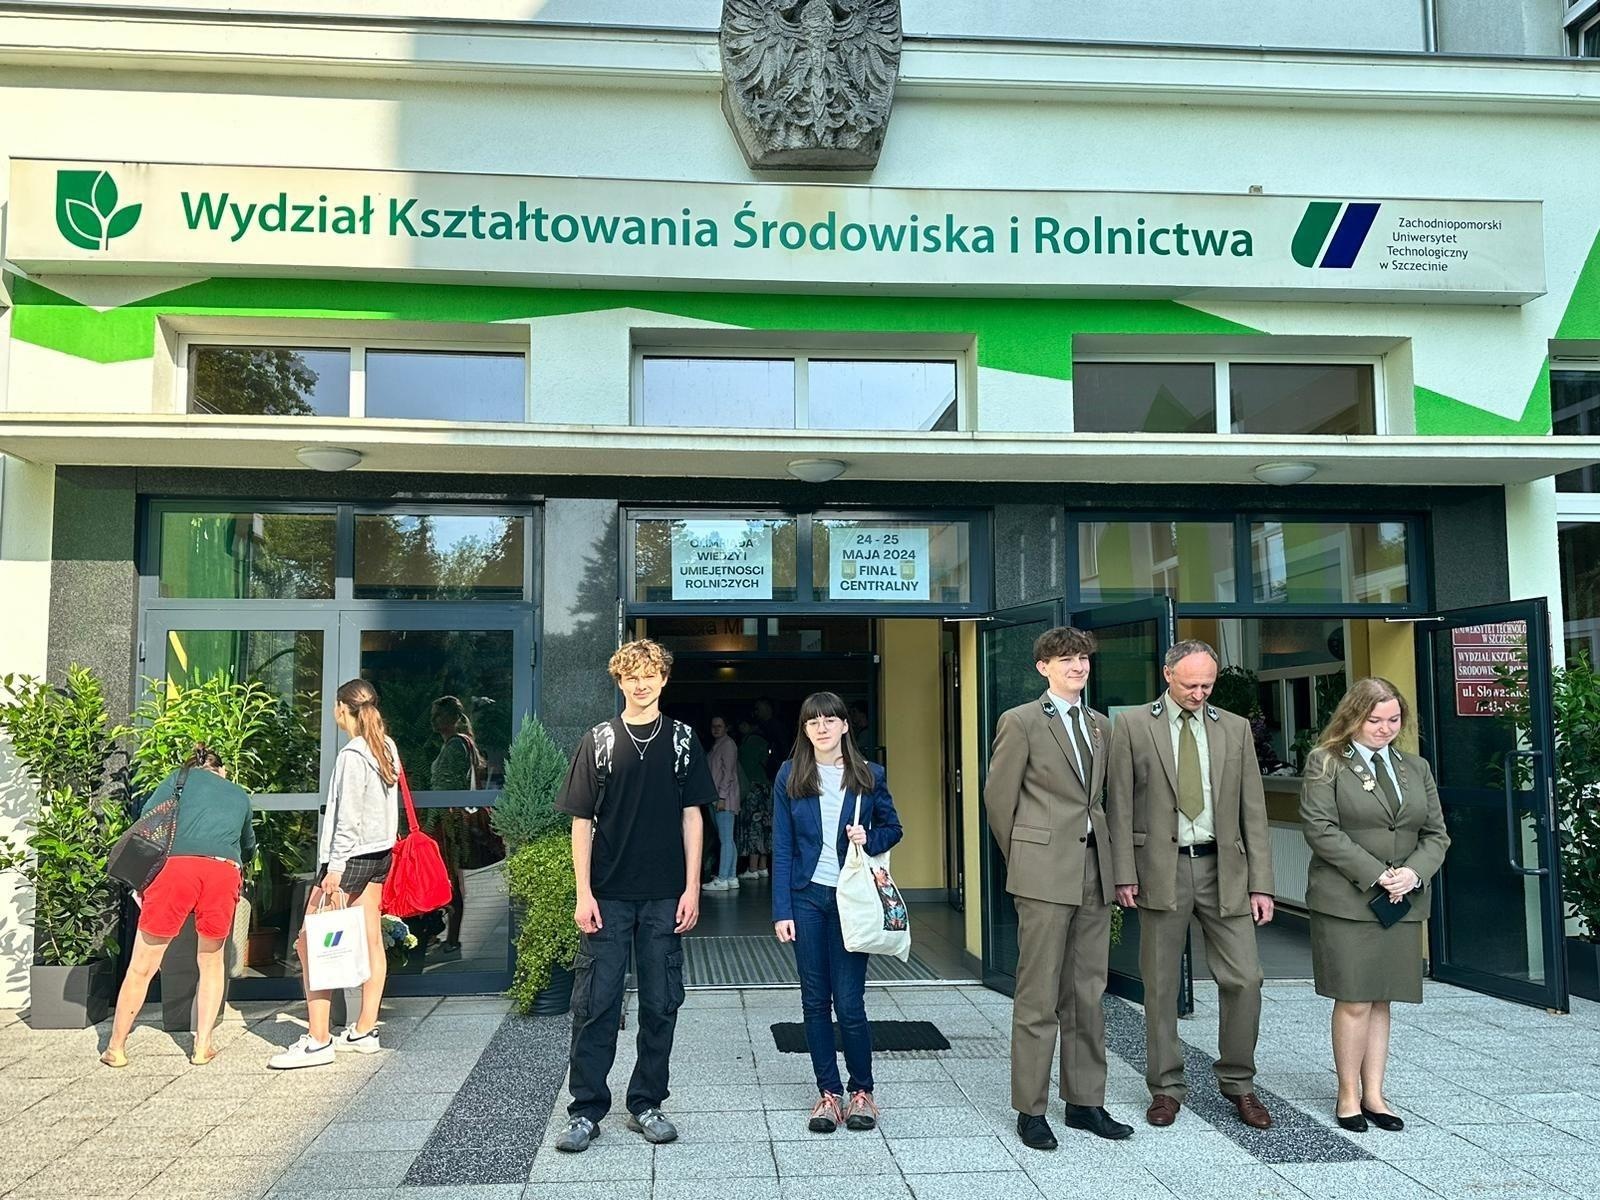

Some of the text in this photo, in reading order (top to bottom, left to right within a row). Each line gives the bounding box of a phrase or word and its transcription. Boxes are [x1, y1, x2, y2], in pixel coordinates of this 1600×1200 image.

[181, 192, 1252, 257] Wydział Kształtowania Środowiska i Rolnictwa
[1398, 217, 1502, 230] Zachodniopomorski
[1392, 231, 1457, 245] Uniwersytet
[1386, 245, 1468, 260] Technologiczny
[1379, 260, 1448, 272] w Szczecinie
[857, 534, 872, 545] 24
[883, 534, 899, 545] 25
[842, 549, 916, 560] MAJA 2024
[685, 579, 759, 588] ROLNICZYCH
[840, 580, 919, 592] CENTRALNY
[1462, 686, 1474, 697] ul.
